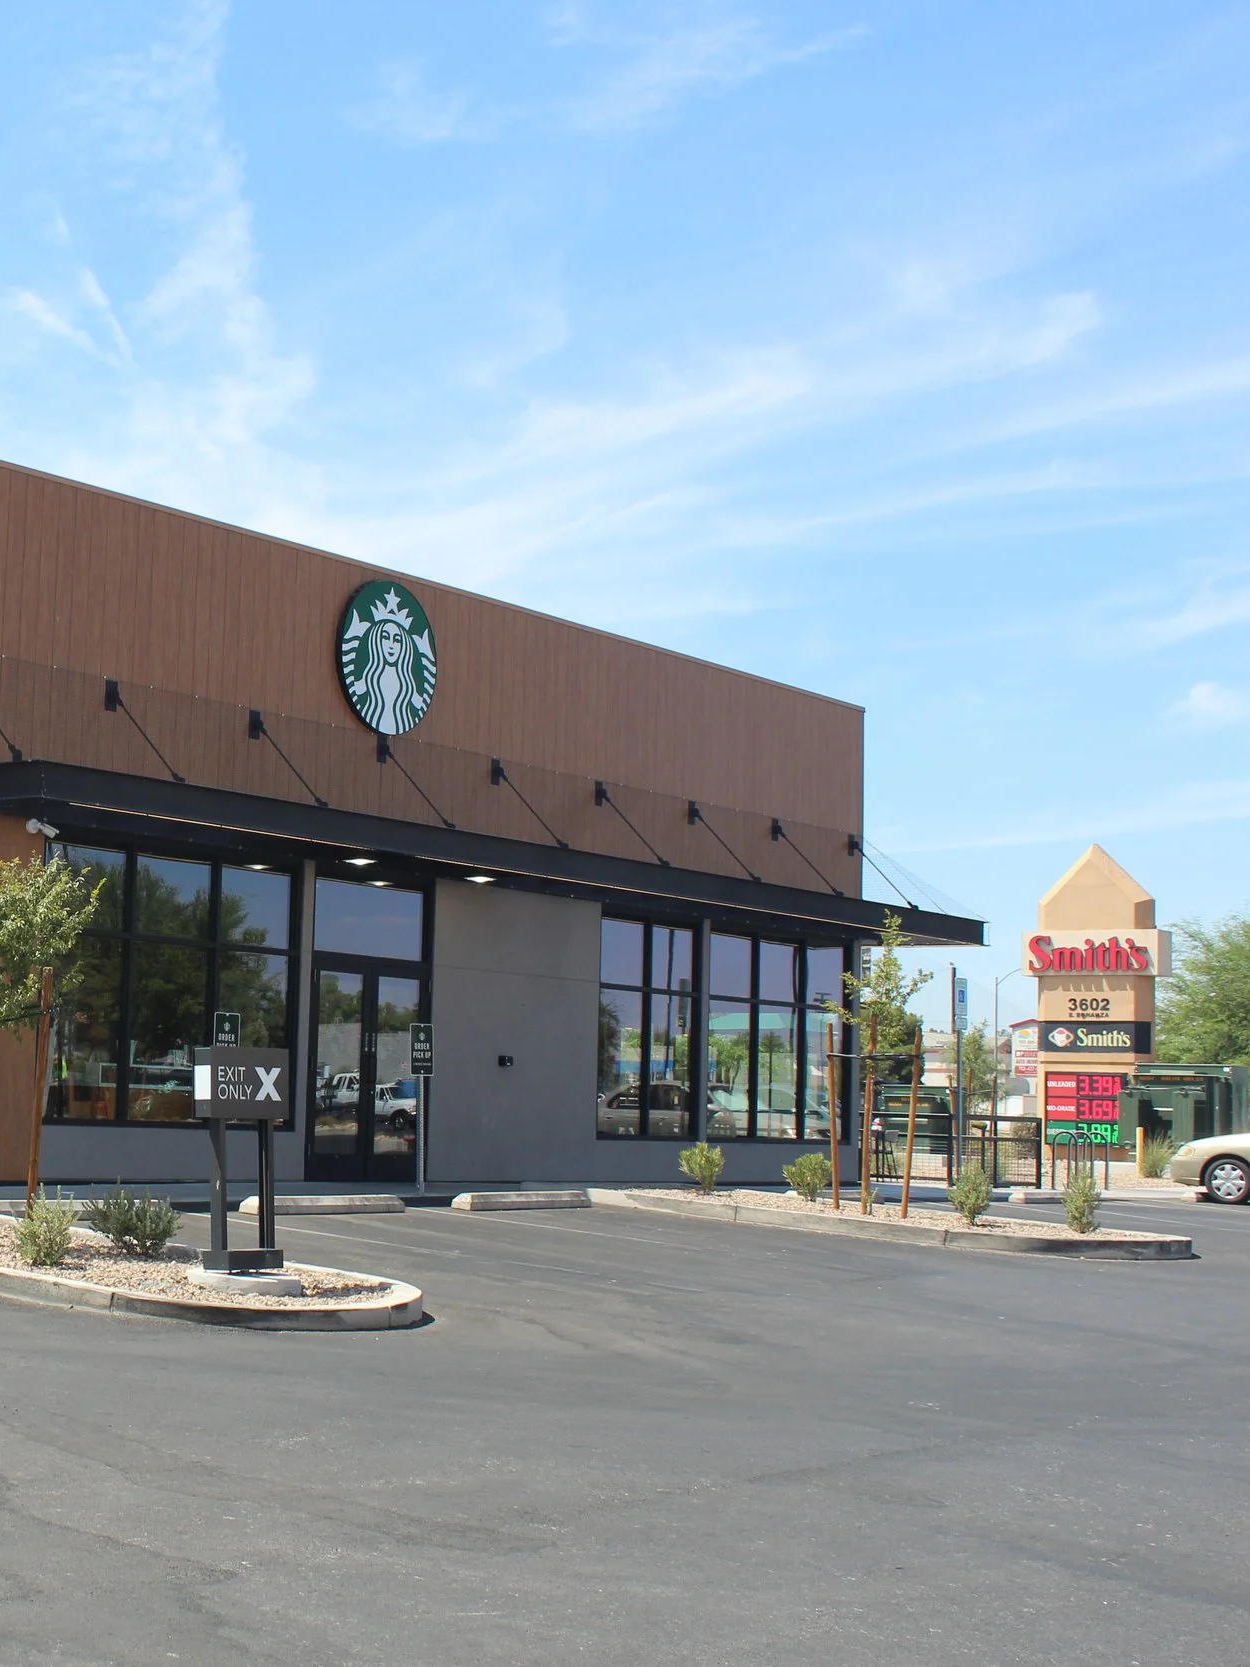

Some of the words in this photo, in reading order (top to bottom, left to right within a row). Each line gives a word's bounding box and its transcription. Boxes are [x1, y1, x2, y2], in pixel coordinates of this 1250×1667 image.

[1028, 935, 1148, 972] Smith's
[1068, 998, 1110, 1012] 3602
[217, 1033, 235, 1042] ORDER
[1076, 1027, 1131, 1047] Smith's
[414, 1042, 430, 1050] ORDER
[412, 1051, 424, 1059] PICK
[424, 1051, 432, 1059] UP
[218, 1066, 246, 1082] EXIT
[217, 1083, 253, 1100] ONLY
[1046, 1080, 1076, 1088] UNLEADED
[1078, 1075, 1112, 1095] 3.39
[1078, 1099, 1112, 1120] 3.69
